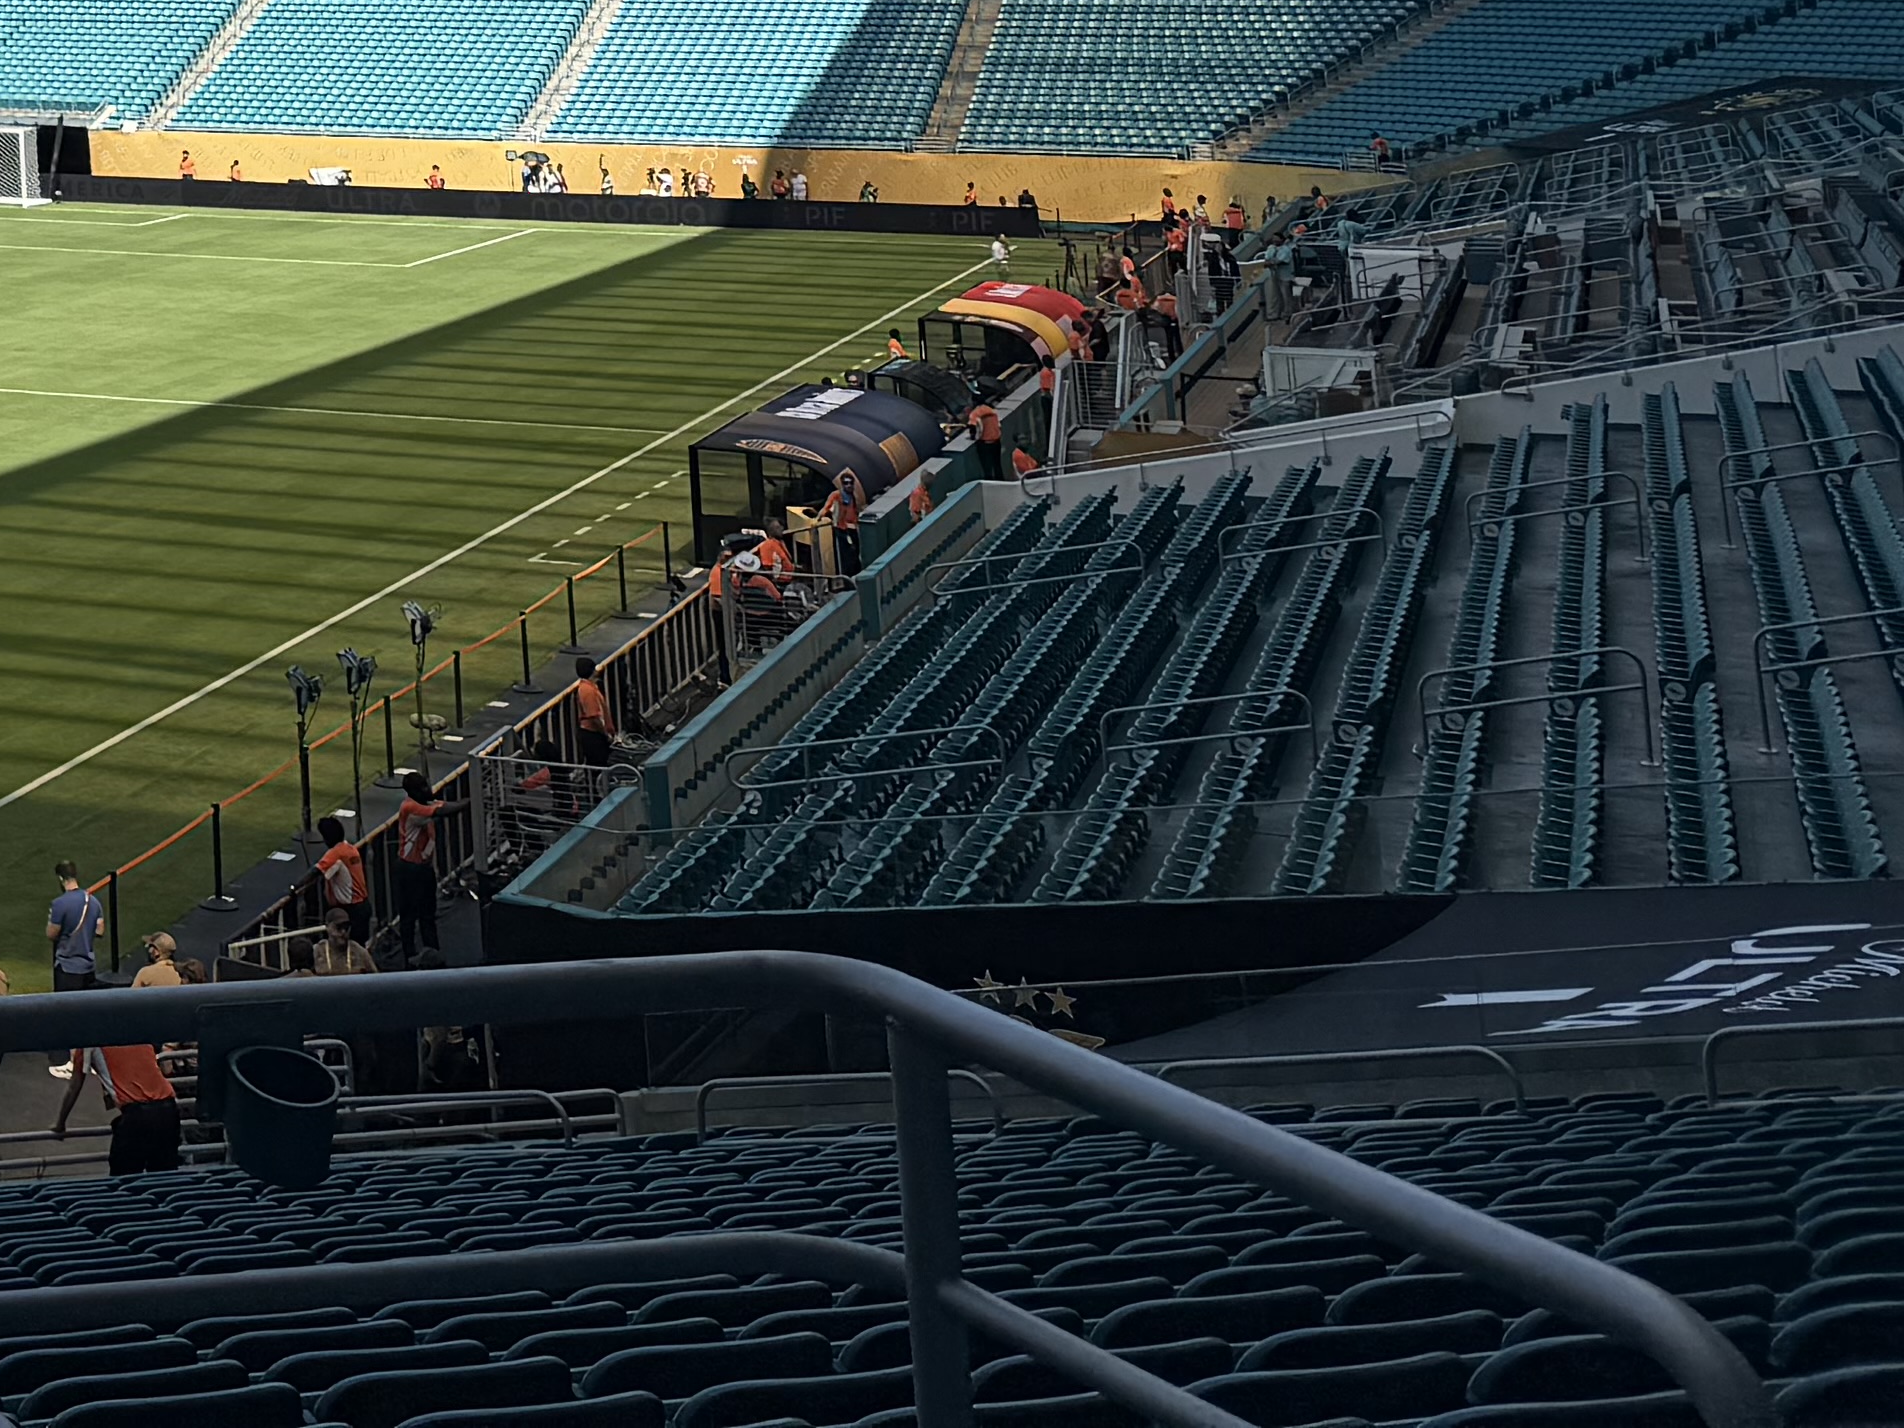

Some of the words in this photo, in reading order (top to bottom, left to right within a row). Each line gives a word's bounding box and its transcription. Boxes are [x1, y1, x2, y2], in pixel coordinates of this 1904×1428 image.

[531, 195, 706, 225] motorola
[805, 206, 845, 227] PIF
[952, 211, 995, 232] PIF
